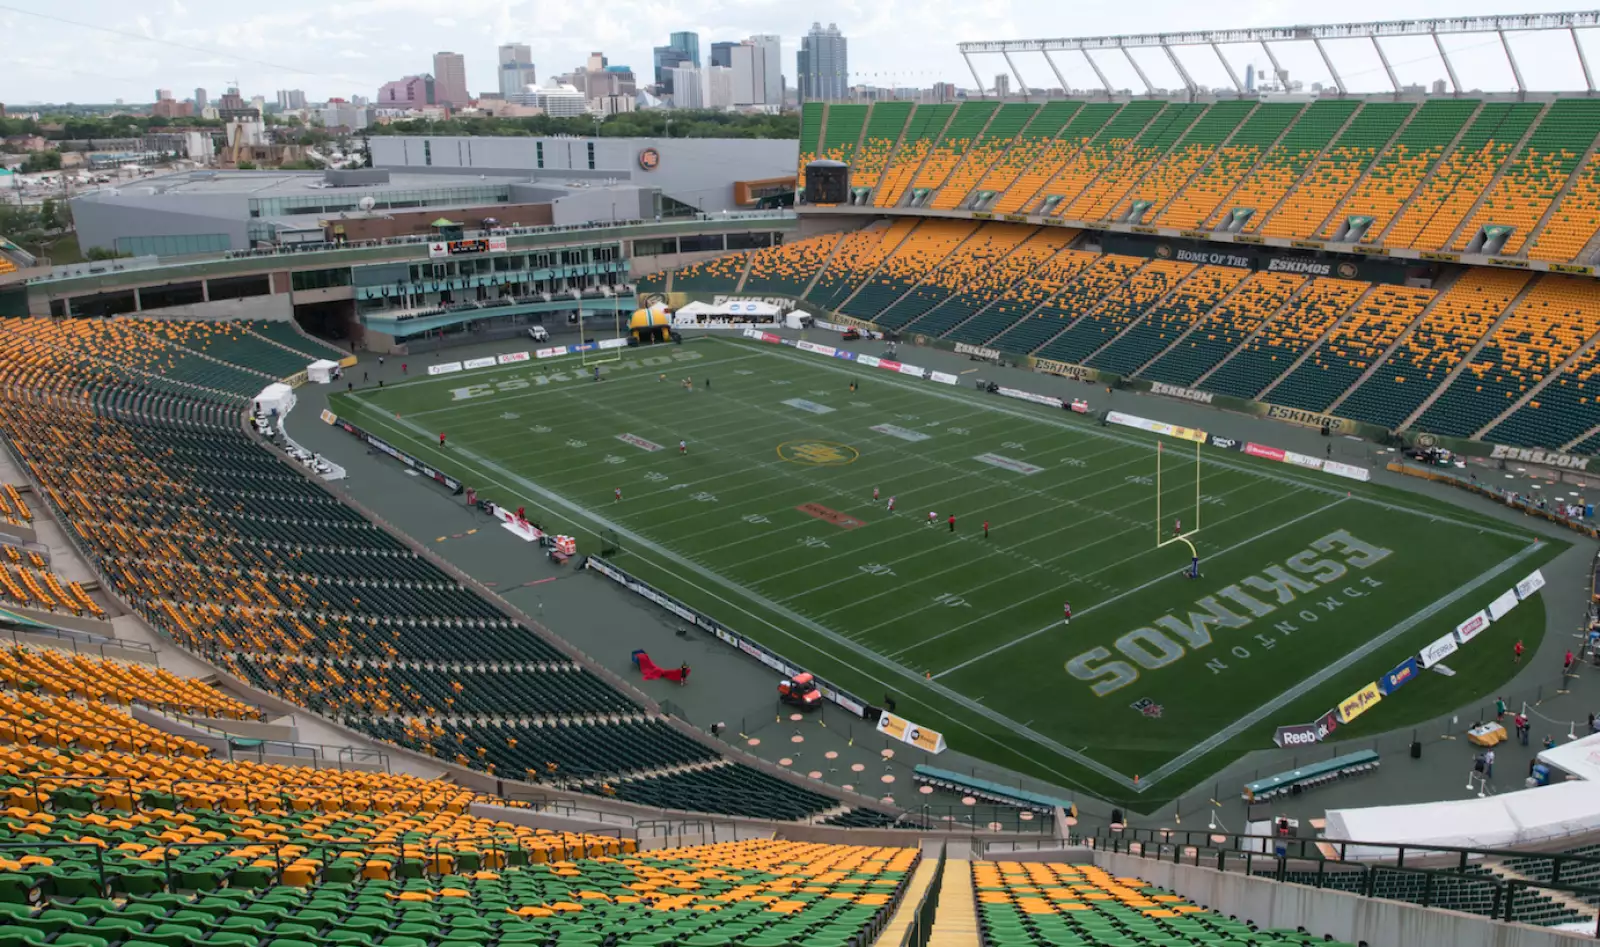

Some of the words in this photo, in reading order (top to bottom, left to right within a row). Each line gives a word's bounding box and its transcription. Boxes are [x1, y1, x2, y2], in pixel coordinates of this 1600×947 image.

[1176, 250, 1207, 263] HOME
[1209, 253, 1226, 265] OF
[1227, 255, 1249, 268] THE
[1267, 259, 1331, 275] ESKIMOS
[448, 350, 703, 401] ESKIMOS
[1035, 359, 1088, 377] ESKIMOS
[1150, 381, 1214, 403] ESKS.COM
[1267, 405, 1342, 430] ESKIMOS
[1490, 443, 1591, 470] ESKS.COM
[1064, 528, 1395, 698] ESKIMOS
